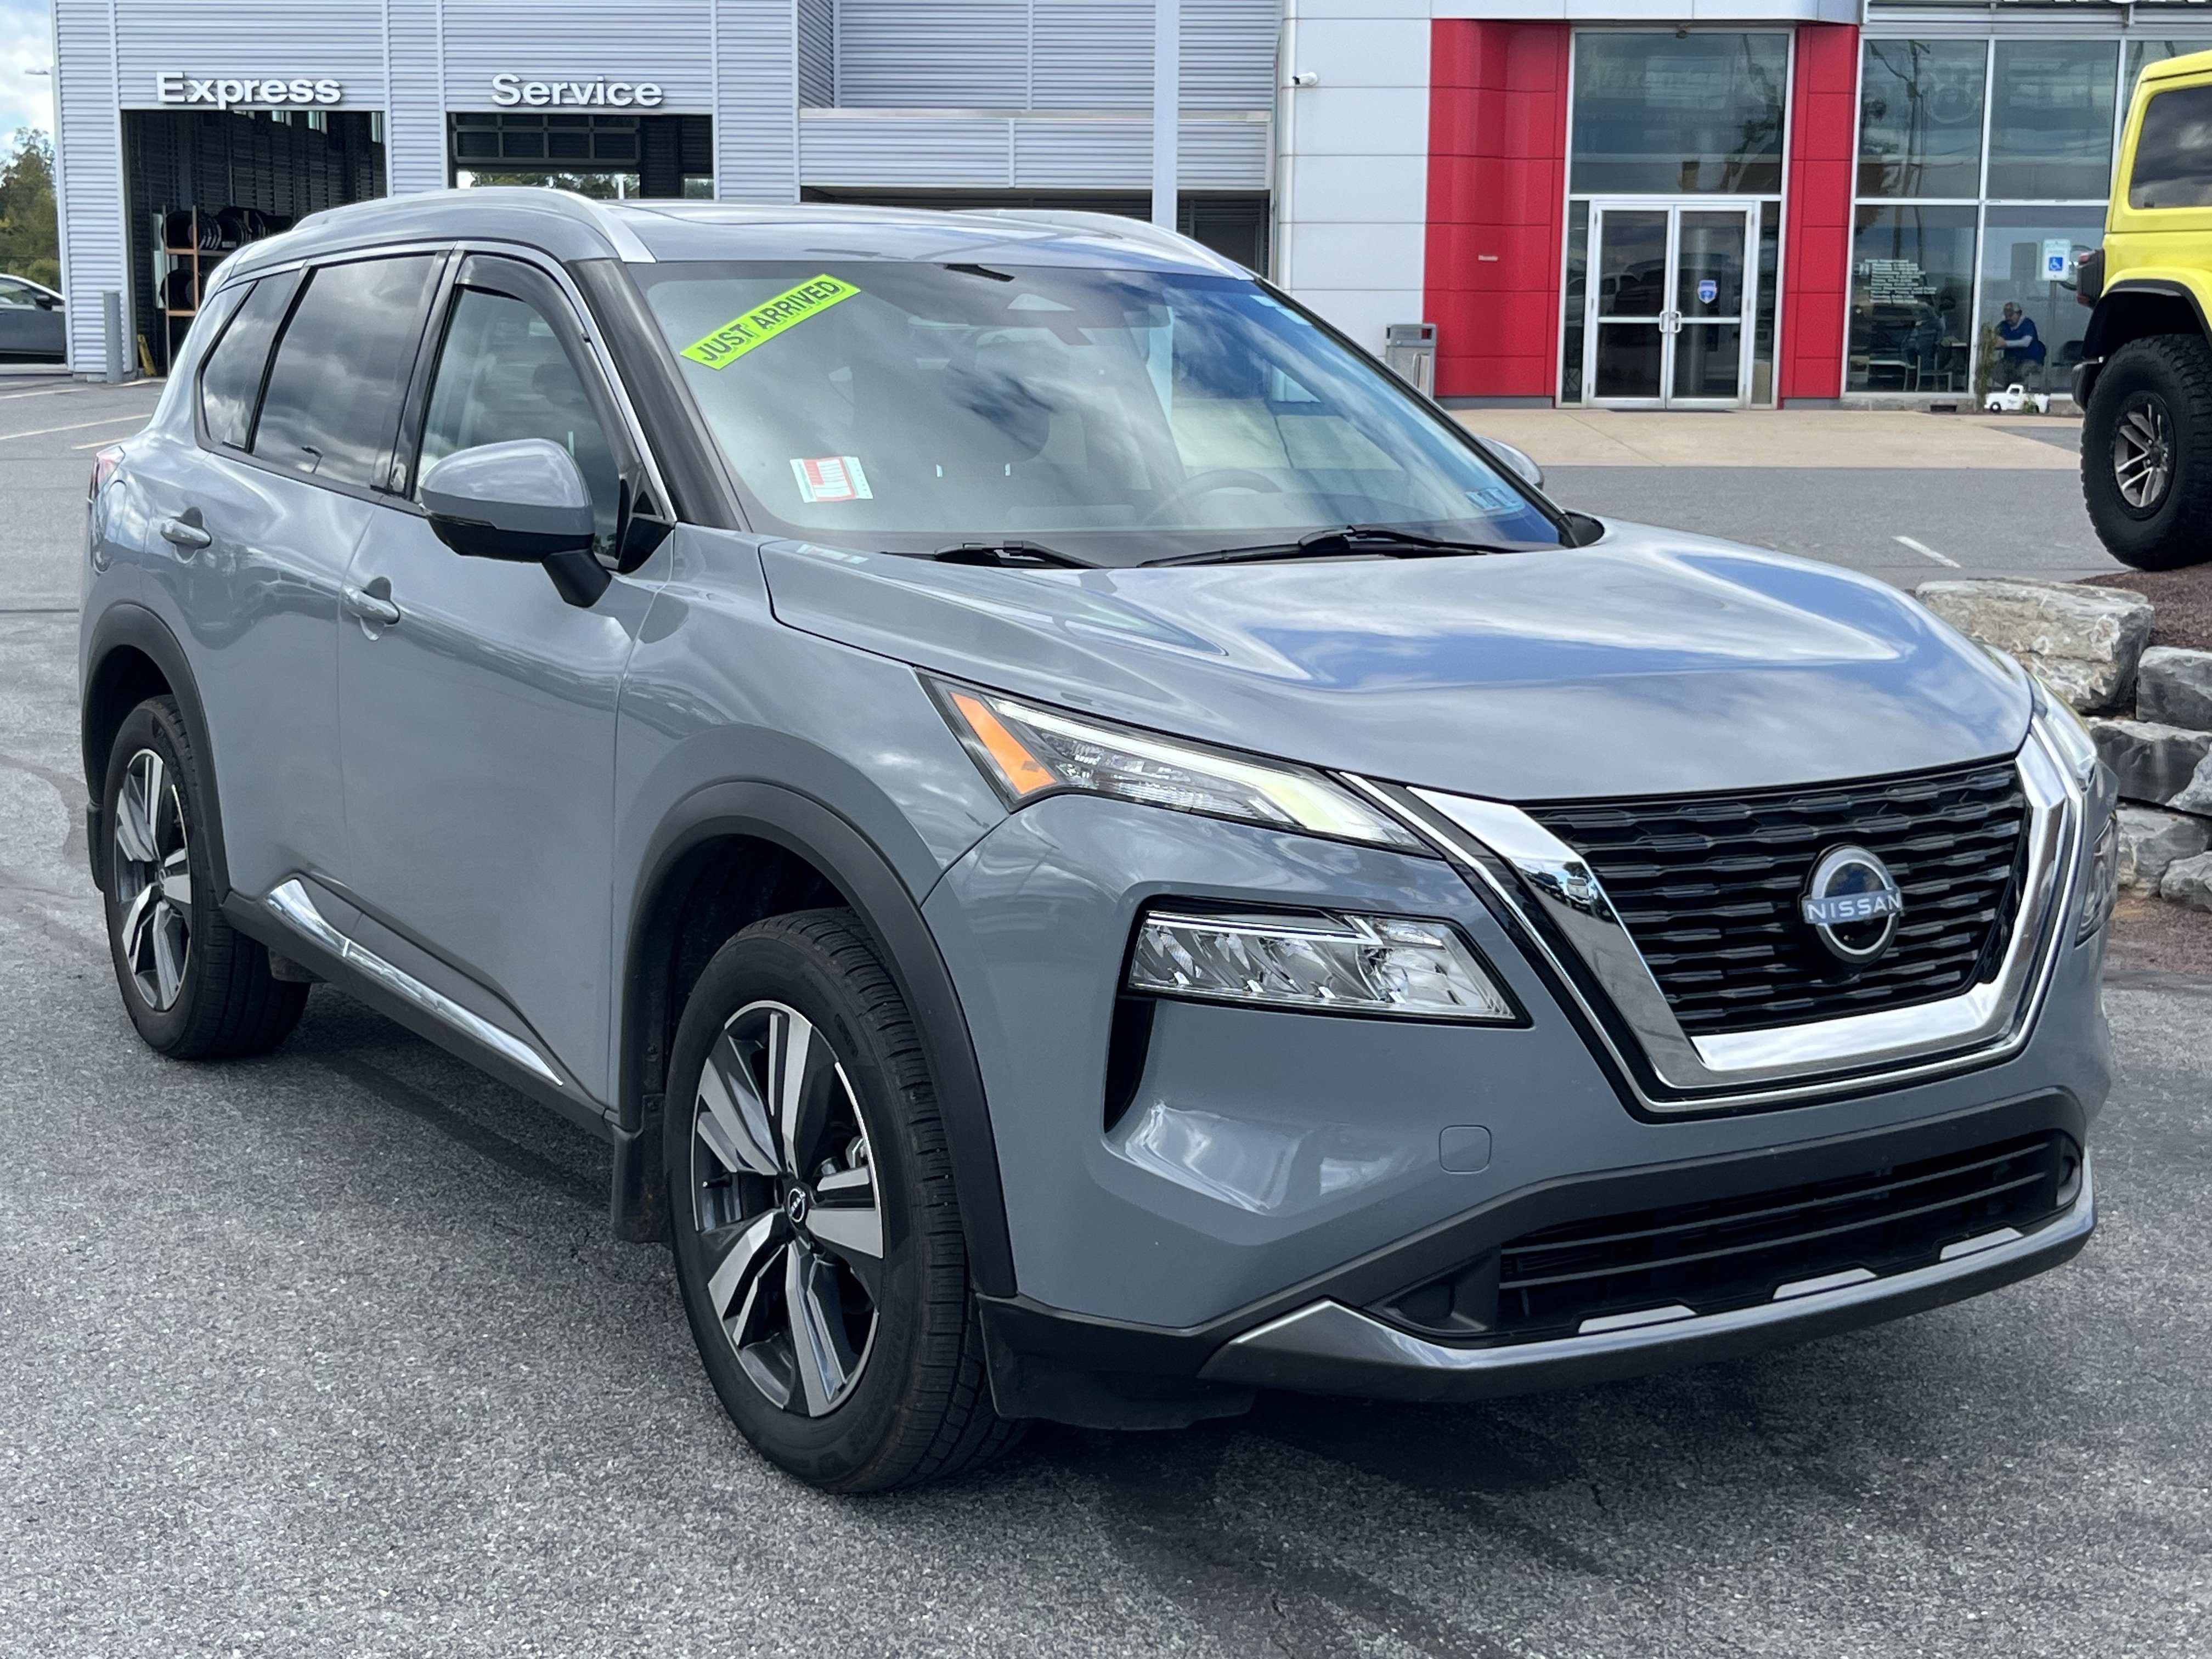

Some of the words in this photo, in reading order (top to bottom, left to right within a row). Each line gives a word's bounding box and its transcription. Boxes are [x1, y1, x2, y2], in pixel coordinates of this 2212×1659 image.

[156, 71, 342, 110] Express
[492, 74, 663, 106] Service
[697, 323, 755, 362] JUST
[749, 280, 842, 330] ARRIVED
[1807, 893, 1904, 920] NISSAN
